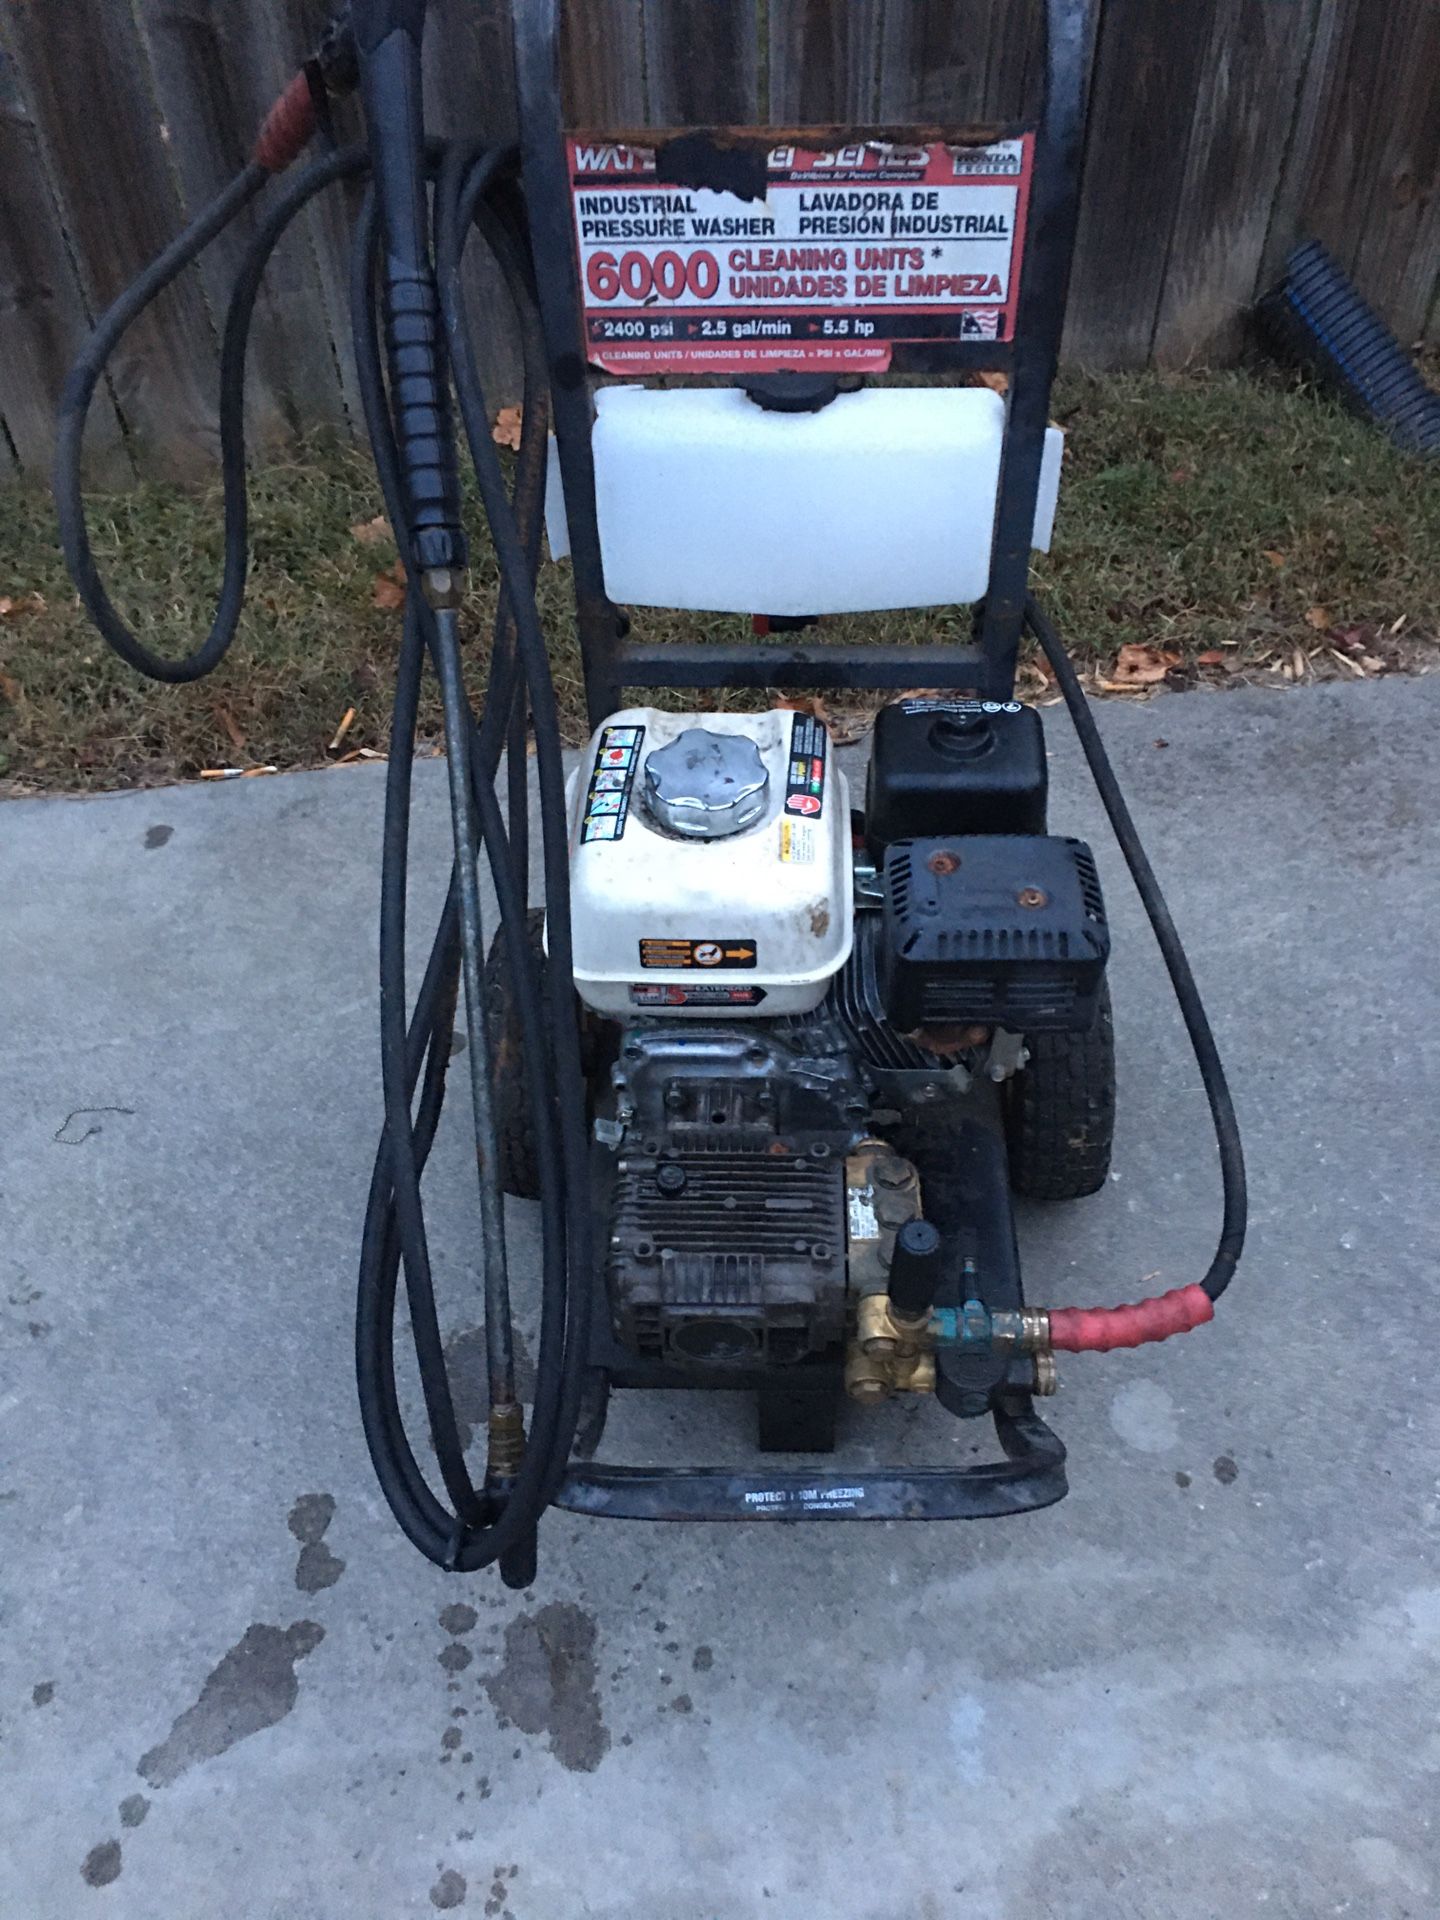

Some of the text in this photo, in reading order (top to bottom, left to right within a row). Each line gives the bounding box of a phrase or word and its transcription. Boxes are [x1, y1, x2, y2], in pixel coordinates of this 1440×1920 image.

[580, 195, 697, 216] INDUSTRIAL
[799, 191, 939, 212] LAVADORA DE
[582, 217, 775, 238] PRESSURE WASHER
[891, 214, 1009, 235] INDUSTRIAL
[728, 247, 924, 272] CLEANING UNITS
[587, 249, 720, 301] 6000
[729, 274, 1002, 299] UNIDADES DE LIMPIEZA
[604, 321, 674, 339] 2400 psi
[701, 319, 792, 338] 2.5 gal/min
[823, 319, 875, 337] 5.5 hp
[602, 351, 651, 360] CLEANING
[653, 350, 682, 359] UNITS
[691, 350, 741, 359] UNIDADES
[743, 350, 758, 359] DE
[760, 349, 806, 359] LIMPIEZA
